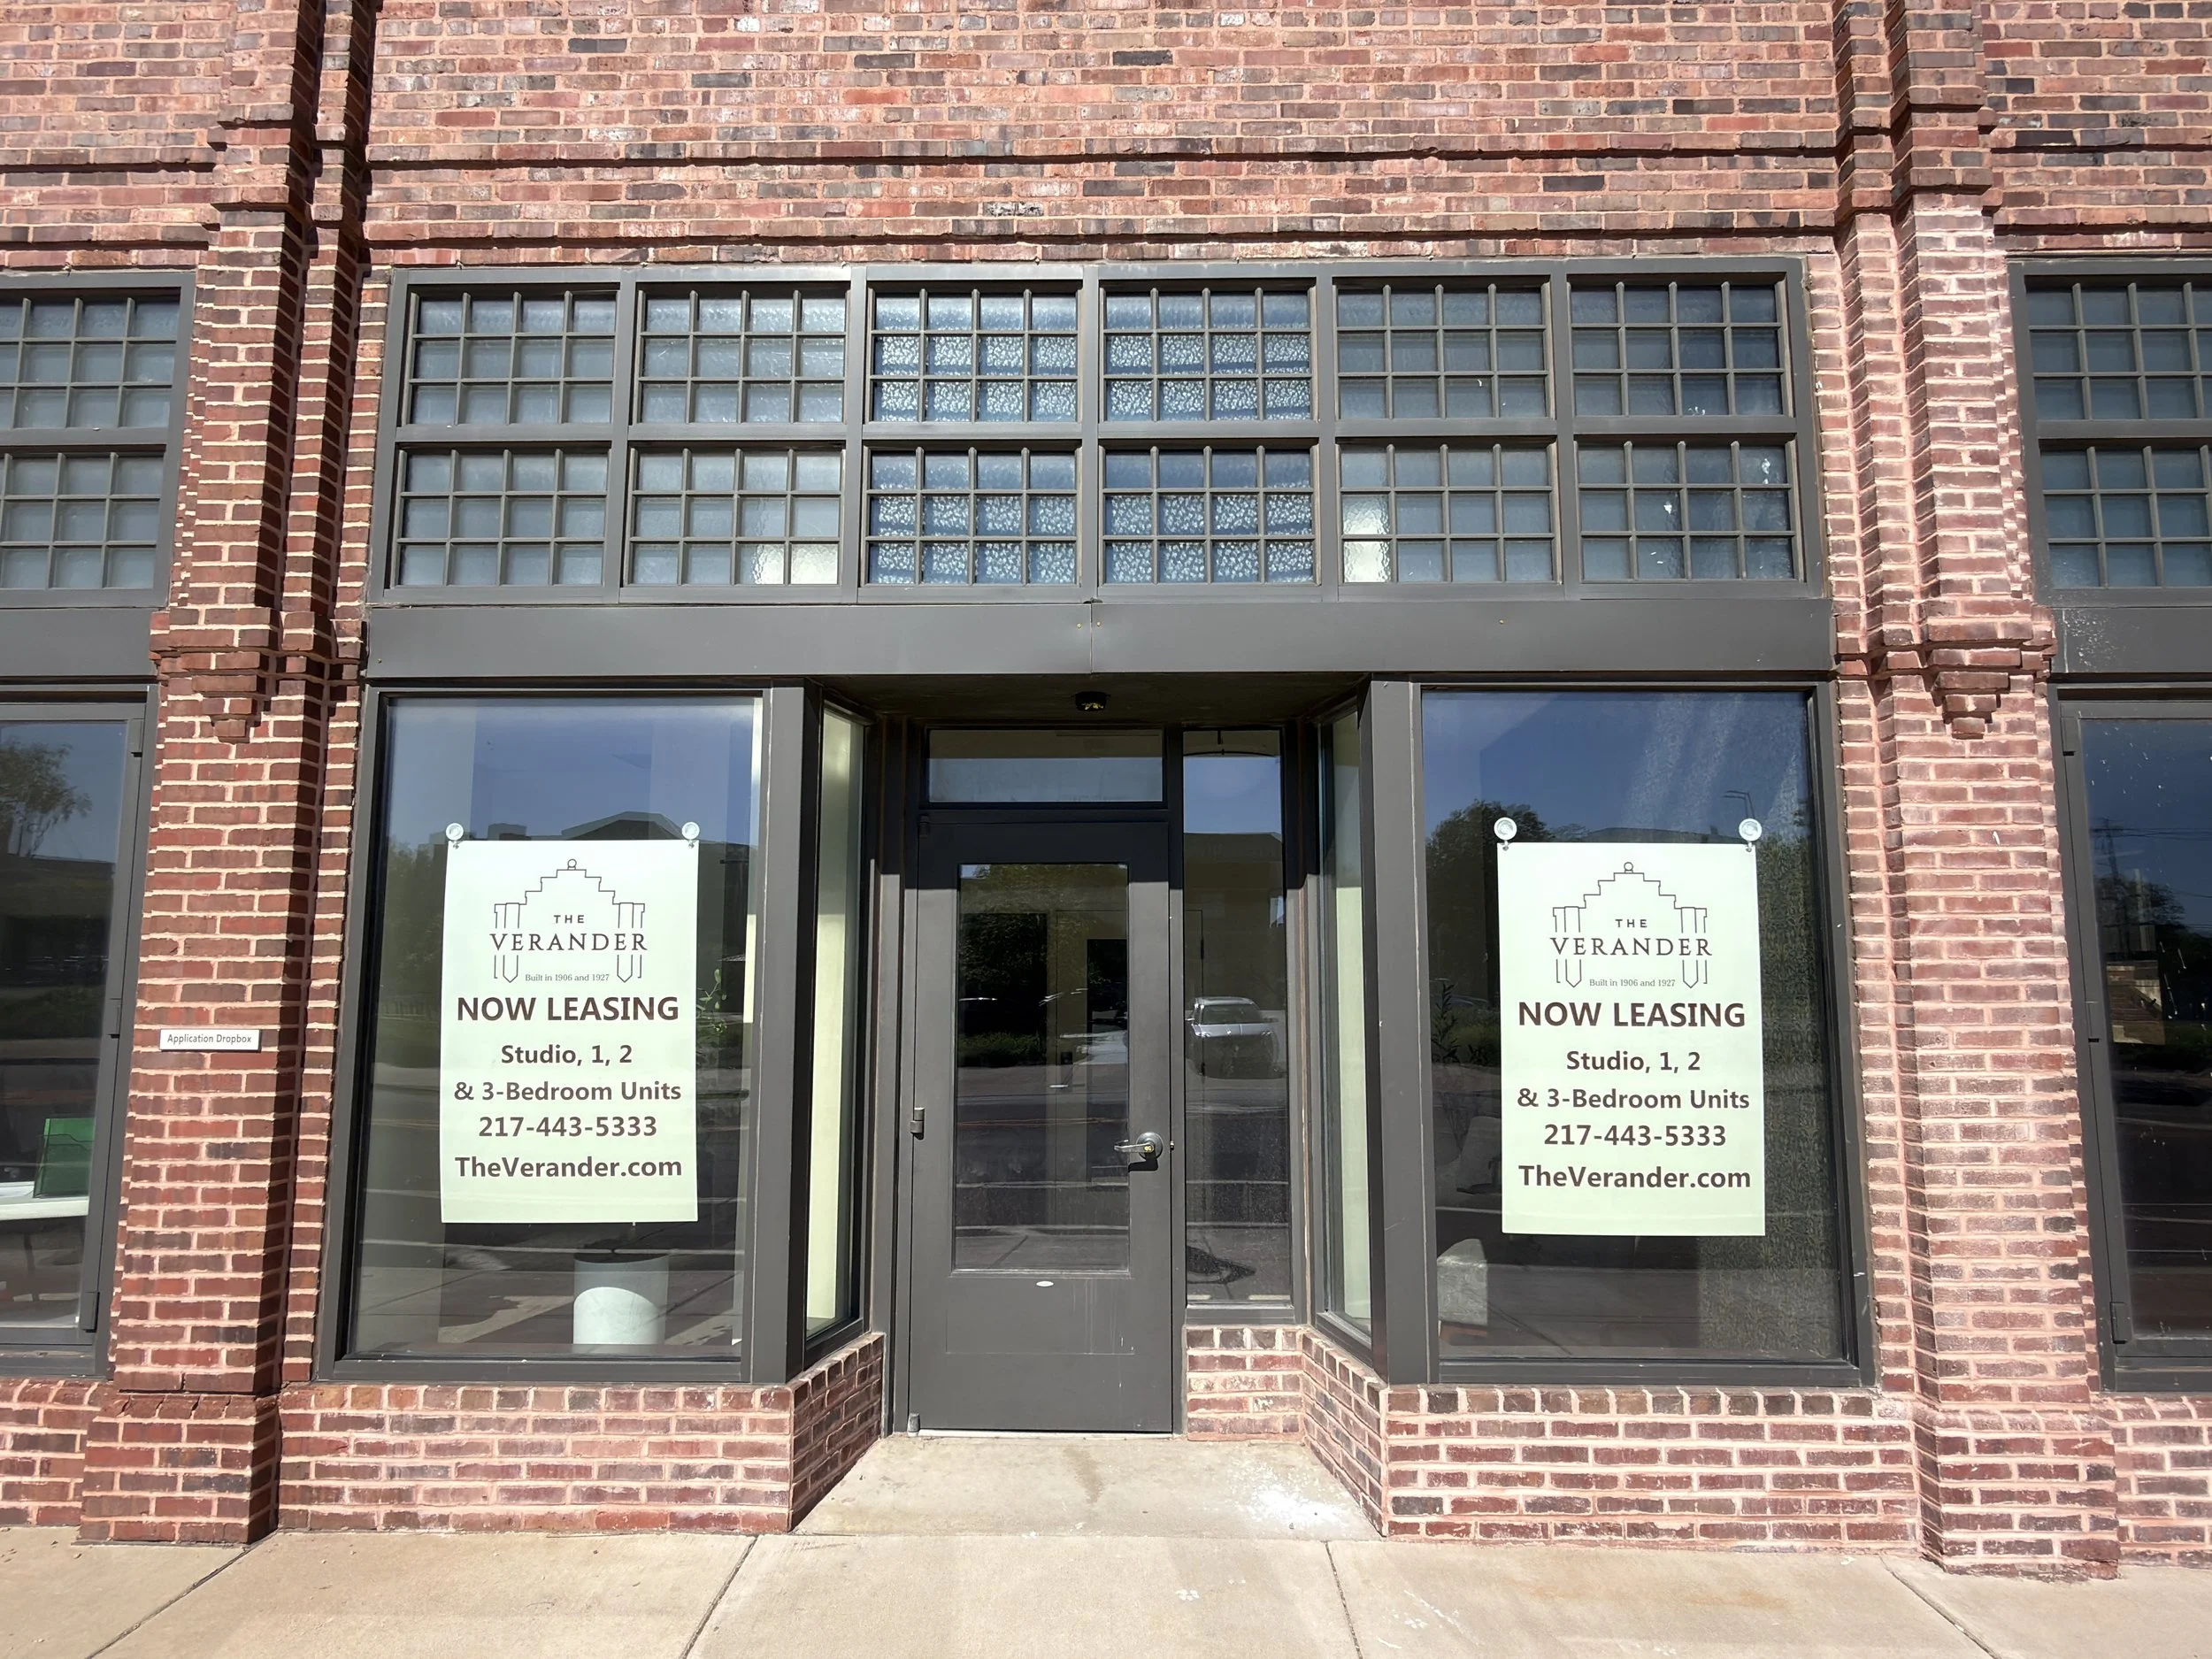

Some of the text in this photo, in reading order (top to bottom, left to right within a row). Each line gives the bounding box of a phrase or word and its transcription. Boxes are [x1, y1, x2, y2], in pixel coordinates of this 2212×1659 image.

[553, 914, 585, 925] THE
[1614, 918, 1647, 928] THE
[488, 933, 649, 951] VERANDER
[1549, 937, 1713, 956] VERANDER
[525, 973, 543, 982] Built
[544, 973, 553, 982] in
[555, 973, 573, 982] 1906
[573, 973, 590, 982] and
[1619, 979, 1639, 987] 1906
[1640, 979, 1655, 987] and
[1658, 979, 1676, 987] 1927
[457, 996, 679, 1022] NOW LEASING
[1518, 1002, 1746, 1028] NOW LEASING
[167, 1033, 252, 1045] Application Dropbox
[501, 1043, 633, 1067] Studio, 1, 2
[1566, 1049, 1701, 1074] Studio, 1, 2
[454, 1080, 682, 1101] & 3-Bedroom Units
[1517, 1087, 1750, 1110] & 3-Bedroom Units
[479, 1115, 657, 1138] 217-443-5333
[1544, 1123, 1726, 1147] 217-443-5333
[454, 1156, 682, 1178] TheVerander.com
[1517, 1164, 1751, 1188] TheVerander.com
